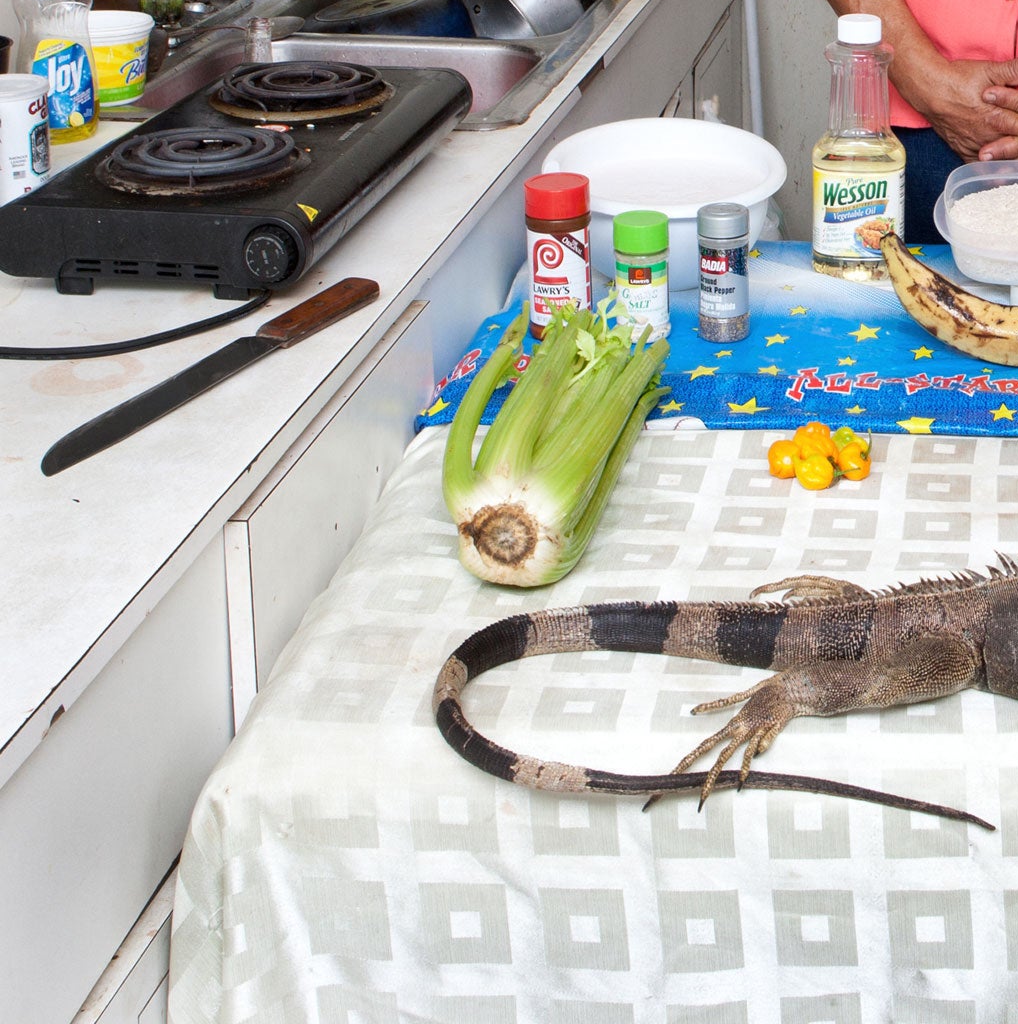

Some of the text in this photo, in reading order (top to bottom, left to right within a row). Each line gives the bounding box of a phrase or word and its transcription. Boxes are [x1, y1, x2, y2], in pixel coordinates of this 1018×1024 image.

[47, 55, 85, 98] Joy
[823, 180, 888, 207] Wesson
[833, 207, 877, 222] Vegetable Oil
[701, 258, 727, 272] BADIA
[533, 284, 570, 295] LAWRY'S
[714, 286, 736, 295] Pepper
[533, 296, 570, 306] SEAONED
[629, 300, 652, 309] SALT
